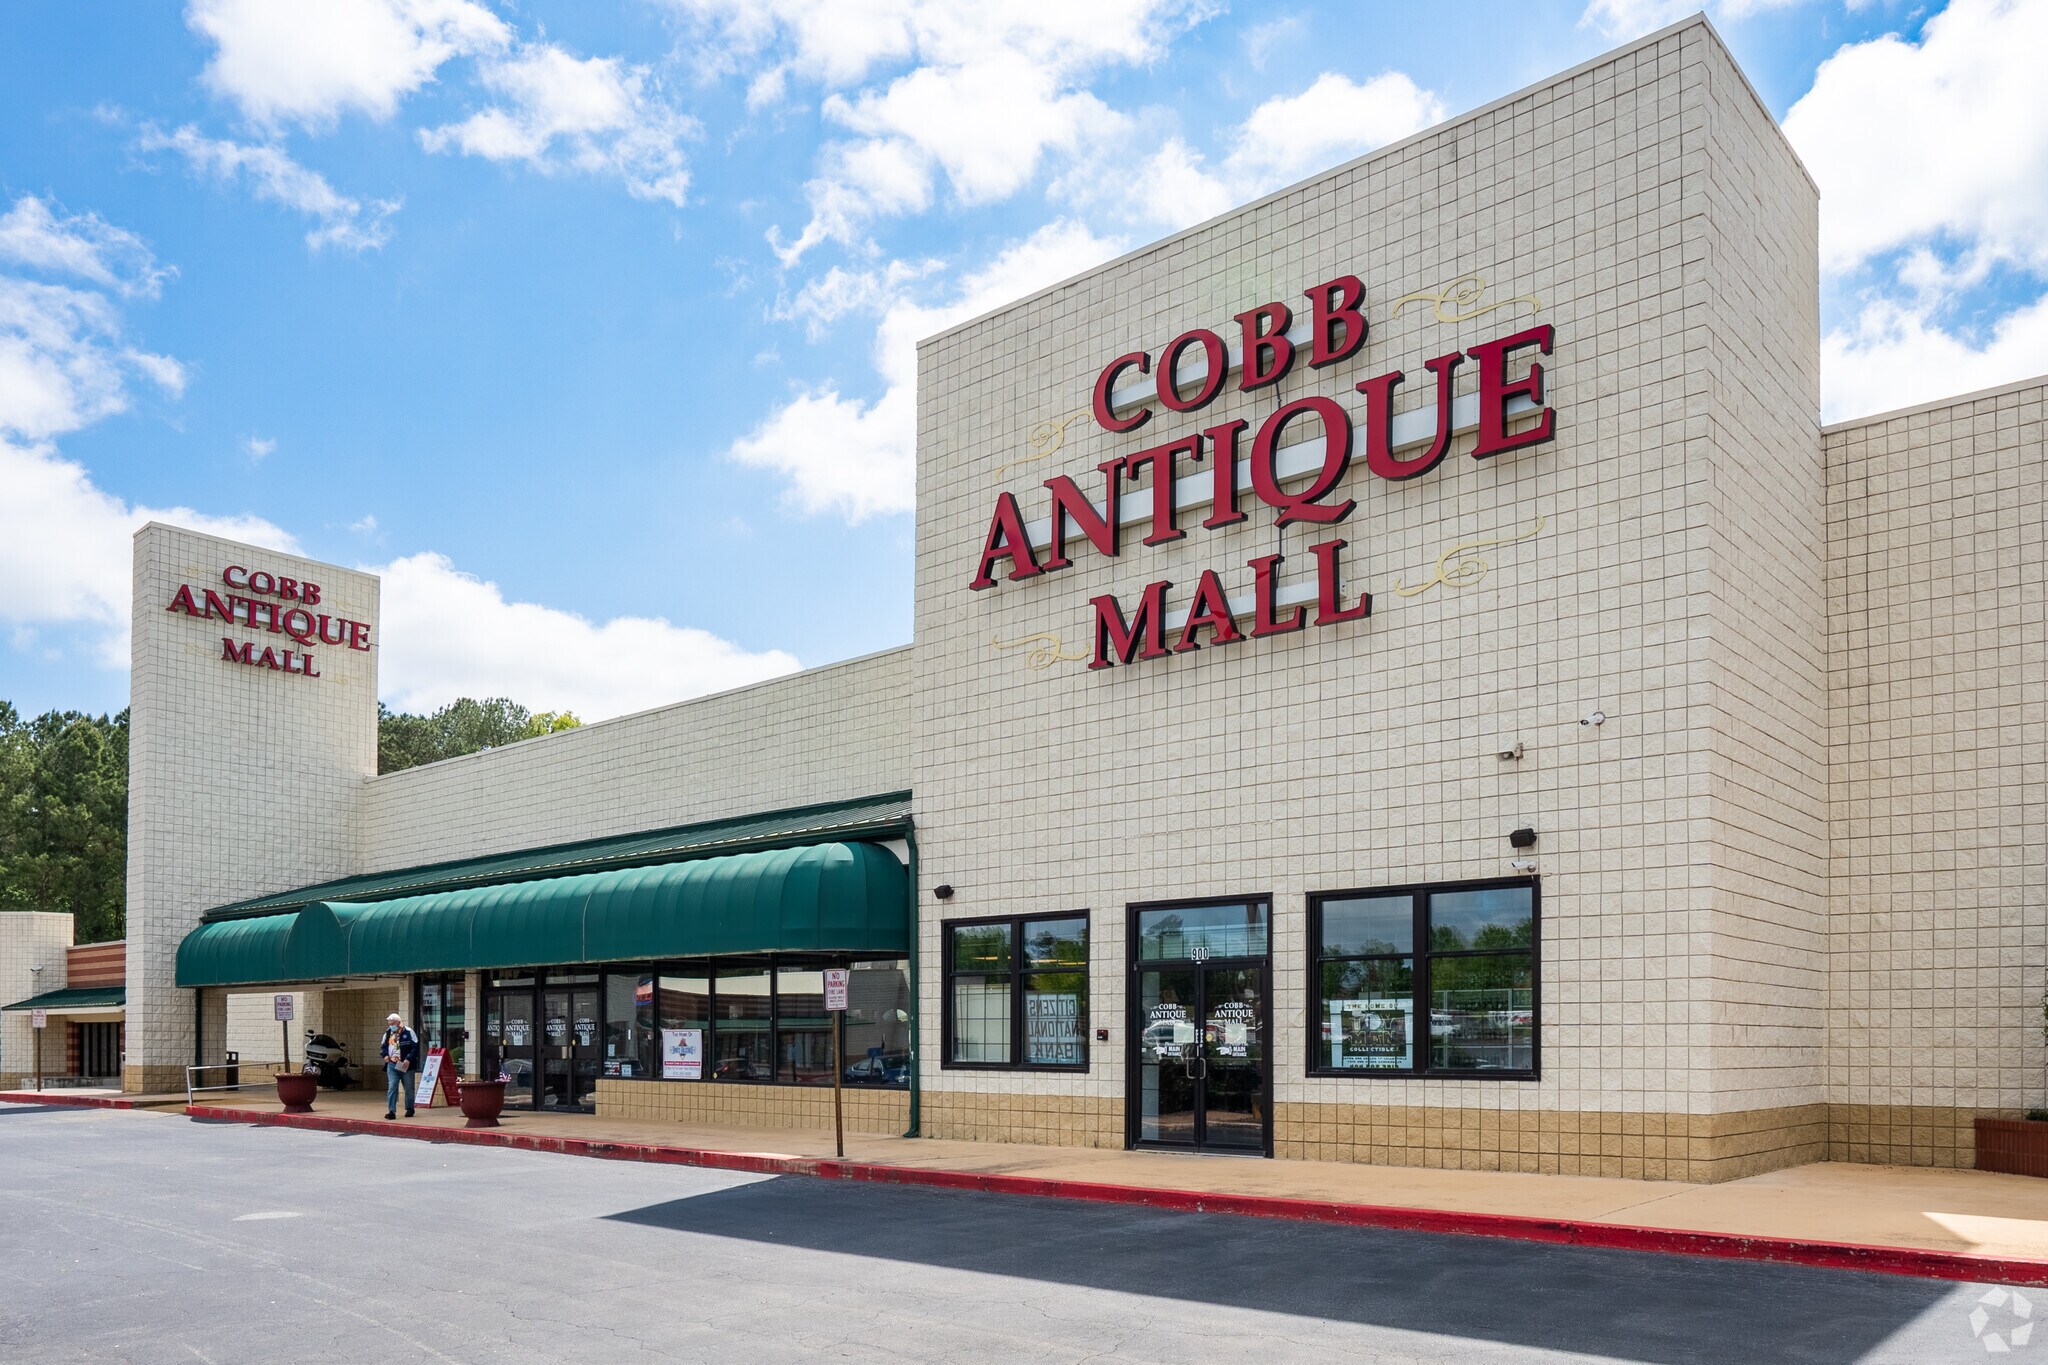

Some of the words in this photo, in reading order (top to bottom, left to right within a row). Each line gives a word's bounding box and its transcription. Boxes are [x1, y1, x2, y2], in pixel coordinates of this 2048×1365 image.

[1093, 275, 1370, 433] COBB
[969, 324, 1556, 591] ANTIQUE
[222, 565, 321, 606] COBB
[1088, 538, 1373, 670] MALL
[166, 583, 372, 652] ANTIQUE
[221, 637, 321, 677] MALL
[1192, 947, 1209, 960] 900
[574, 1023, 595, 1031] ANTIQUE
[1150, 1010, 1187, 1019] ANTIQUE
[1214, 1009, 1254, 1019] ANTIQUE
